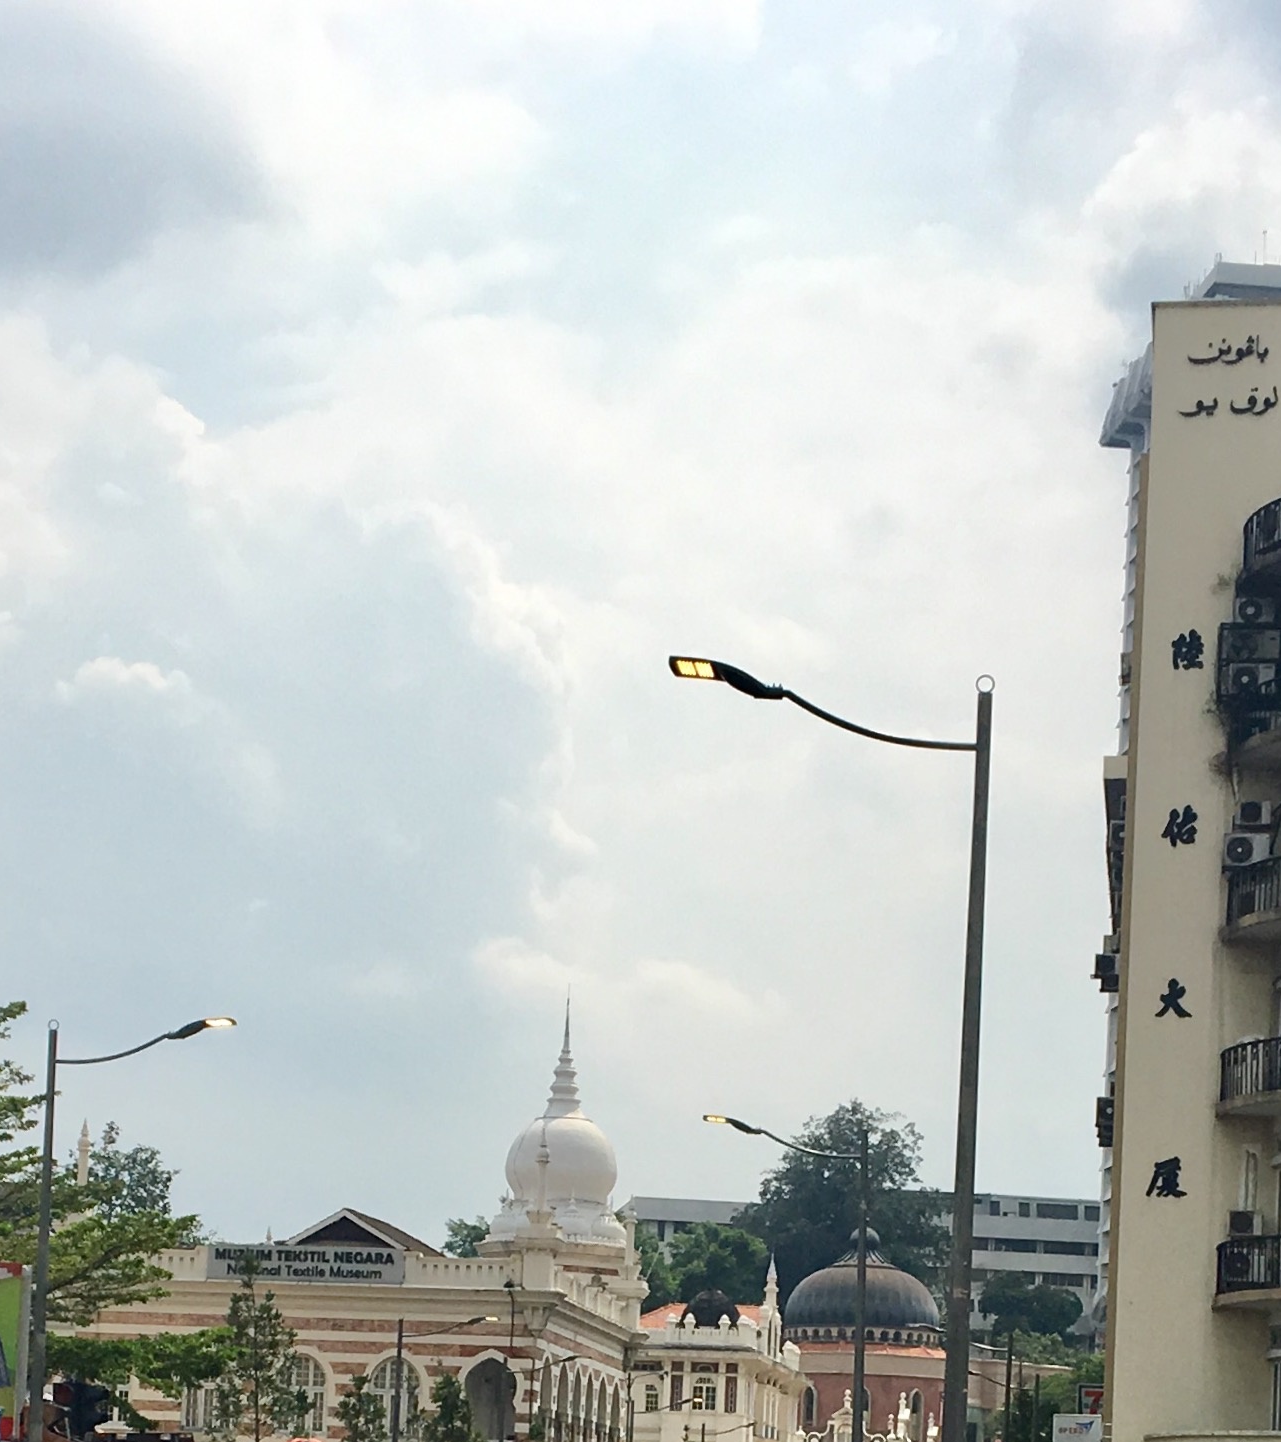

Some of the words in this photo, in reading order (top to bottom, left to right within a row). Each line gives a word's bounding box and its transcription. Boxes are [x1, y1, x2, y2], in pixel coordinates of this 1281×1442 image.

[215, 1247, 272, 1262] MUZUM
[277, 1250, 330, 1264] TEKSTIL
[333, 1252, 395, 1266] NEGARA
[226, 1263, 281, 1277] Naonal
[285, 1264, 326, 1278] Textile
[329, 1265, 383, 1280] Museum
